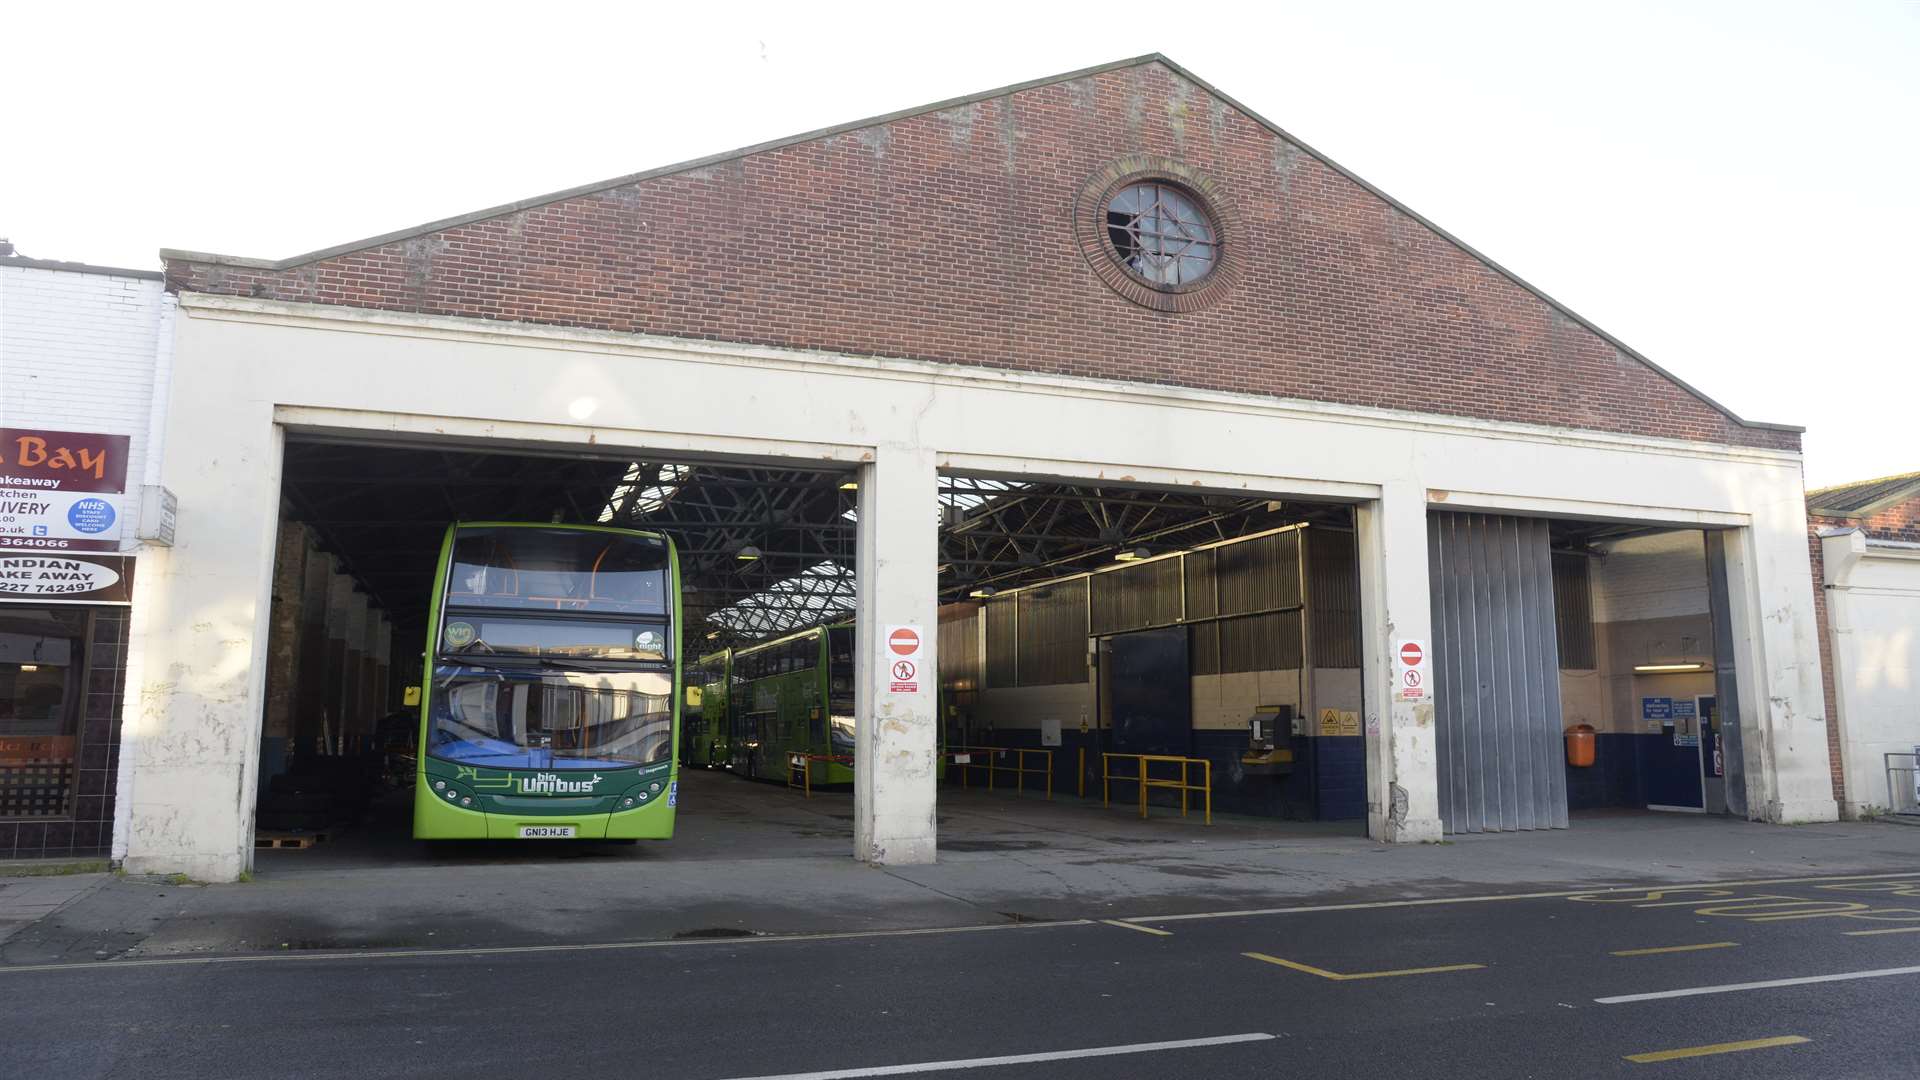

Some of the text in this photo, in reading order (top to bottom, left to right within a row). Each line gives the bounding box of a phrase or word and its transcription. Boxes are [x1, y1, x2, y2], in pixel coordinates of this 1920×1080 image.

[0, 490, 37, 499] tchen
[1, 501, 50, 515] IVERY
[78, 502, 105, 510] NHS
[0, 538, 69, 548] 364066
[0, 560, 80, 570] NDIAN
[39, 572, 93, 581] AWAY
[0, 582, 94, 593] 227 742497
[537, 772, 557, 782] bio
[525, 828, 569, 836] GN13 HJE
